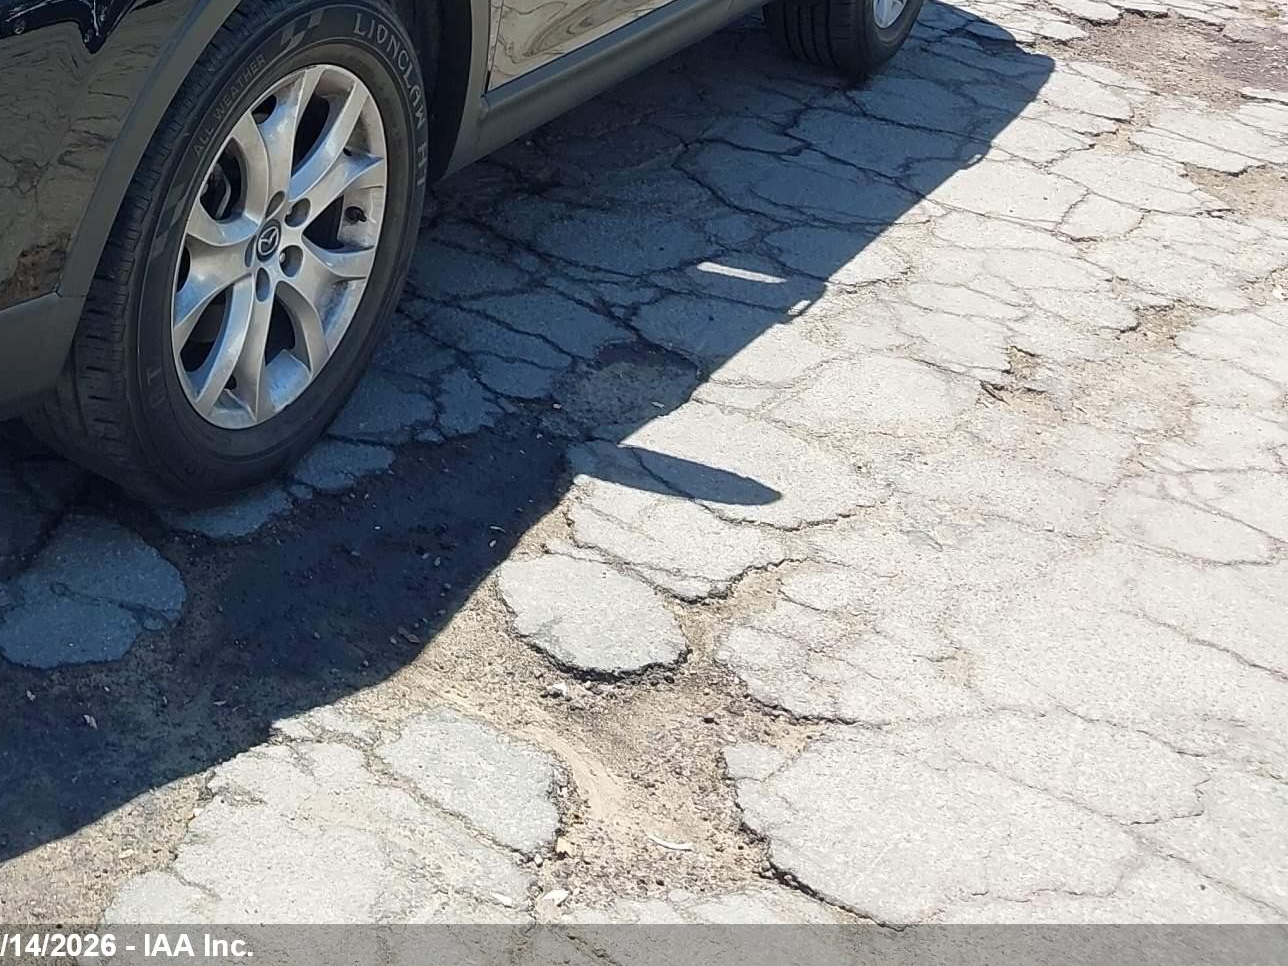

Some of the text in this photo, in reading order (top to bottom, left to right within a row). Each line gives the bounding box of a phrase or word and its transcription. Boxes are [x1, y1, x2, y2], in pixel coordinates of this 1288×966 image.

[193, 54, 267, 157] ALL WEATHER
[353, 12, 426, 130] LIONCLAW
